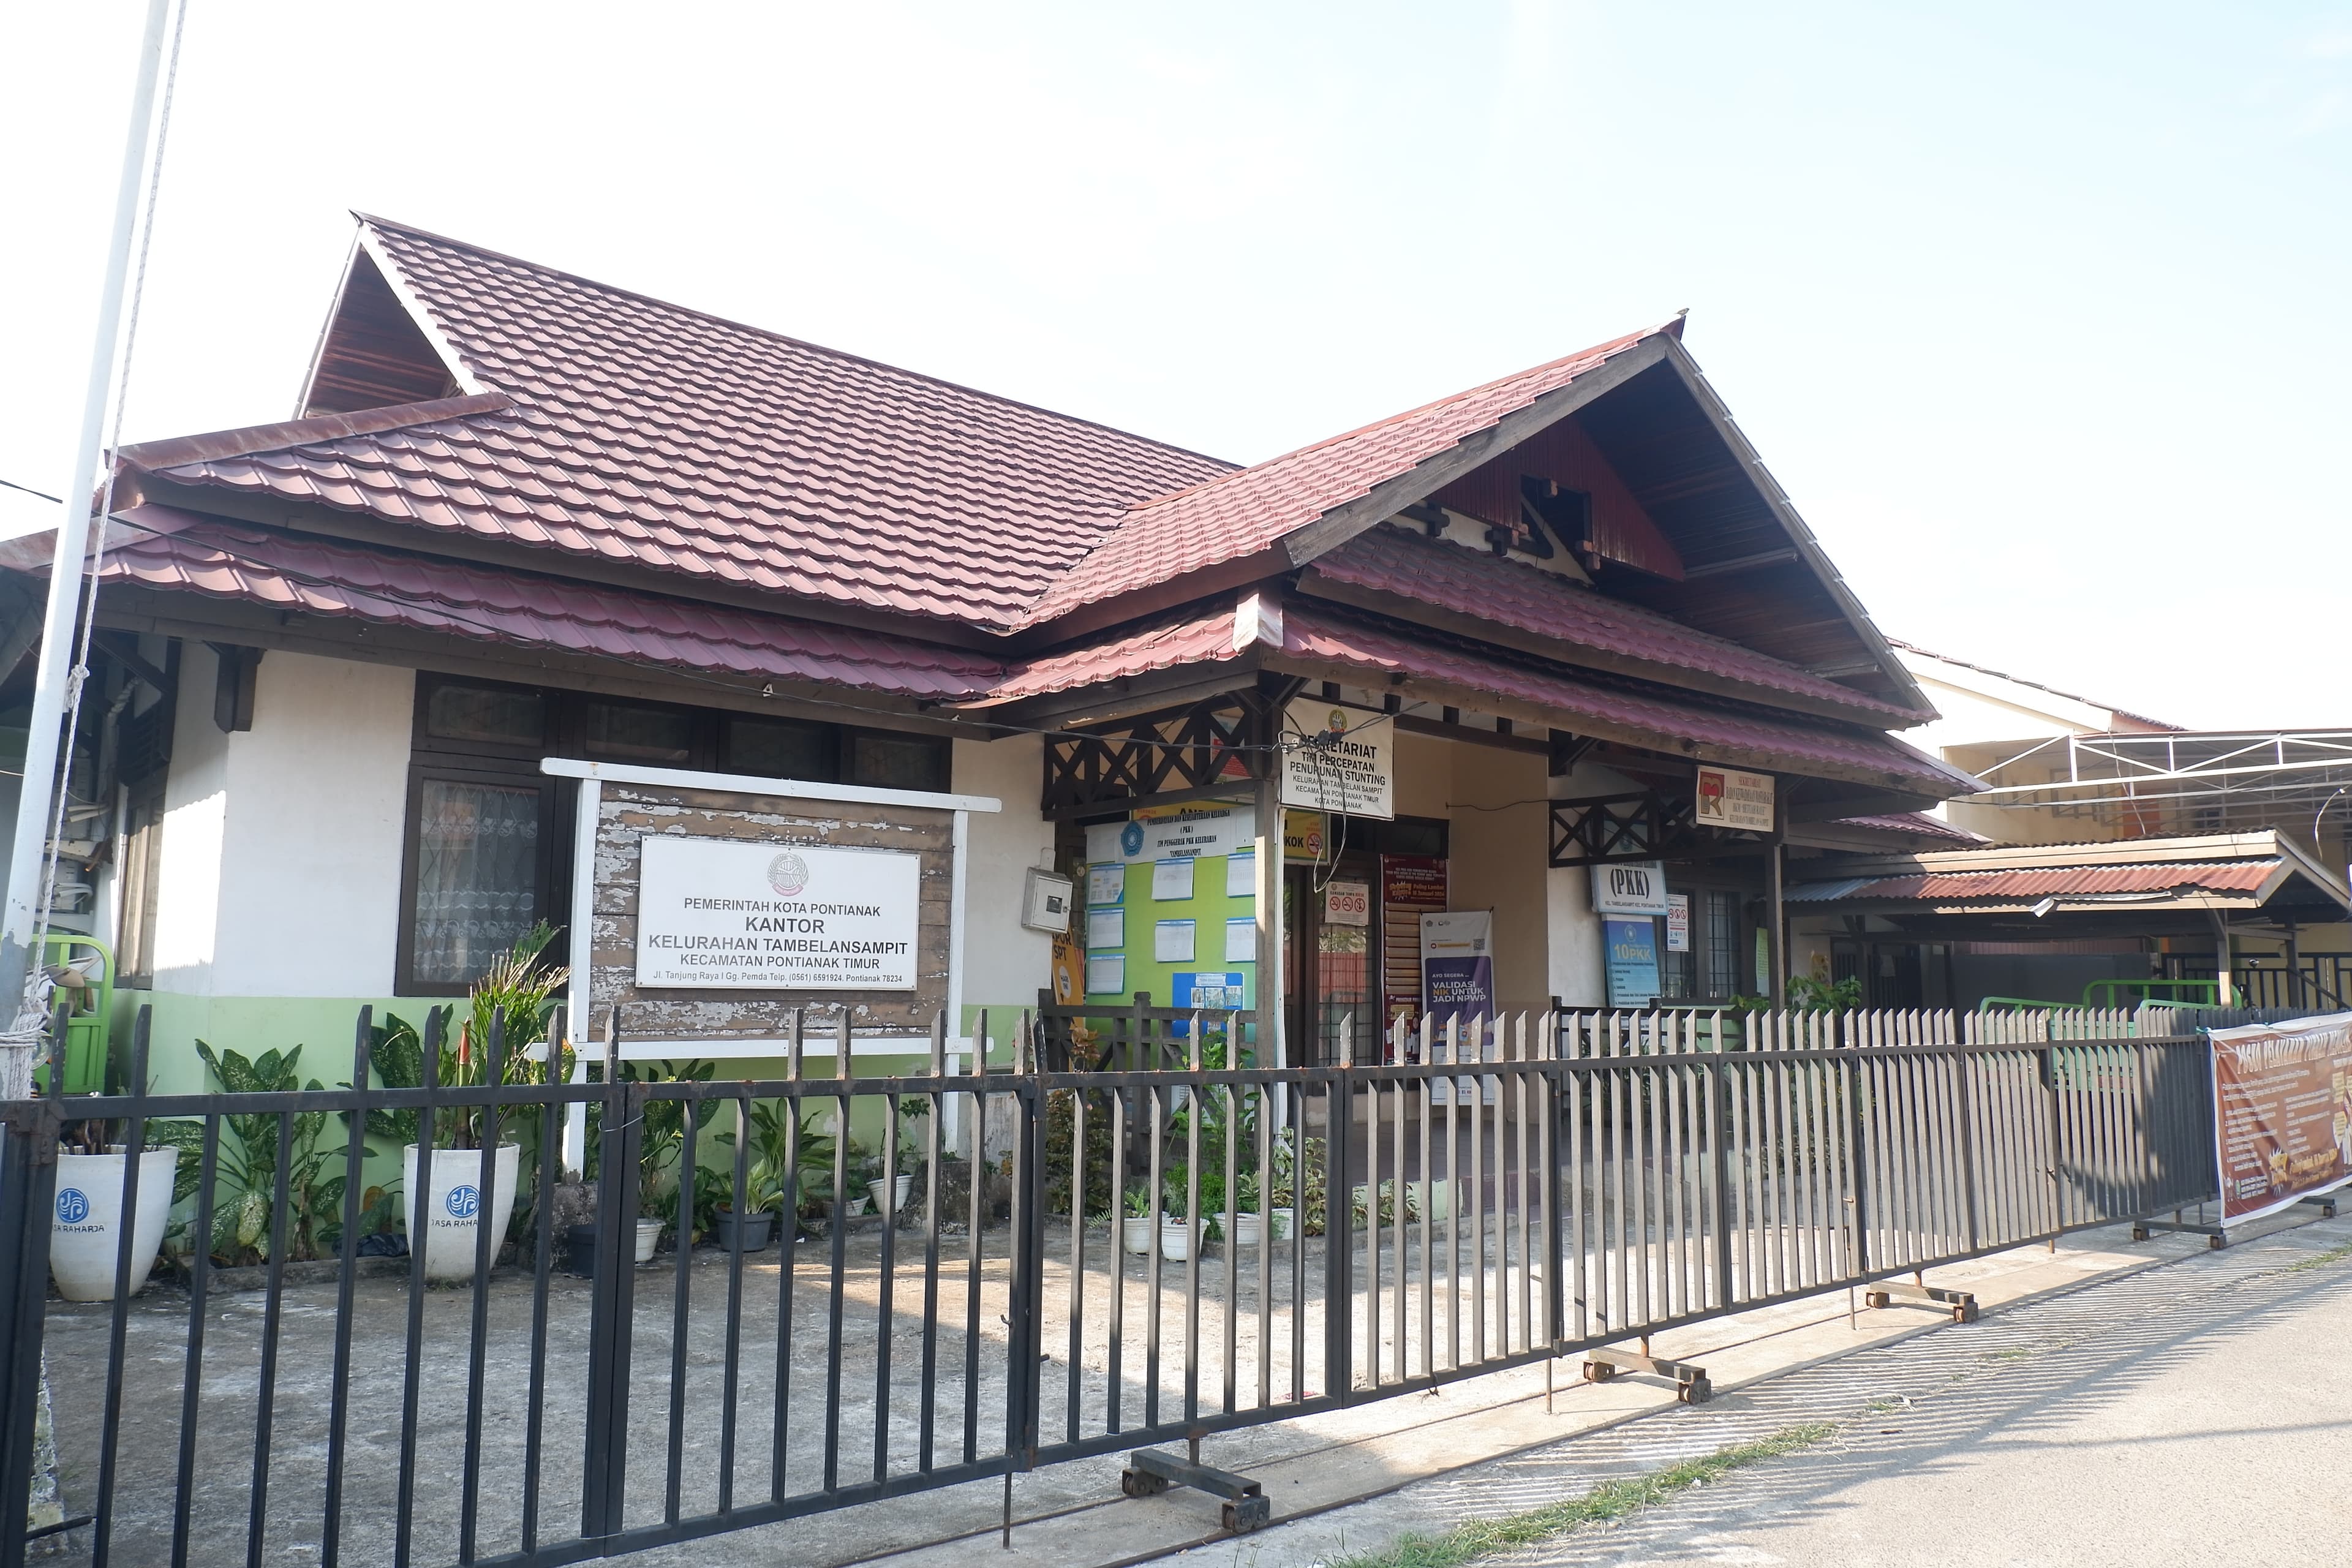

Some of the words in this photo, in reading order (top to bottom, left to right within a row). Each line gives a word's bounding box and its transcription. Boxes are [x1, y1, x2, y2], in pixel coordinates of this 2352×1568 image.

[1319, 755, 1374, 772] PERCEPATAN
[1345, 771, 1385, 786] STUNTING
[1295, 785, 1330, 796] KECAMAAN
[1362, 786, 1382, 795] SAMPIT
[1331, 799, 1362, 809] PONIANAK
[1284, 835, 1303, 848] KOK
[1610, 869, 1649, 899] (PKK)
[684, 898, 769, 911] PEMERINTAH
[774, 902, 807, 913] KOTA
[810, 903, 881, 916] PONTIANAK
[745, 917, 824, 933] KANTOR
[649, 935, 757, 951] KELURAHAN
[763, 938, 908, 954] TAMBELANSAMPIT
[1614, 944, 1629, 959] 10
[1629, 948, 1652, 960] PKK
[680, 954, 763, 967] KECAMATAN
[767, 956, 839, 968] PONTIANAK
[843, 958, 880, 969] TIMUR
[665, 971, 697, 981] Tanjung
[699, 971, 718, 981] Raya
[726, 972, 739, 981] Gg.
[770, 973, 787, 982] Telp.
[790, 973, 811, 982] (0561)
[454, 1219, 478, 1227] RAHA
